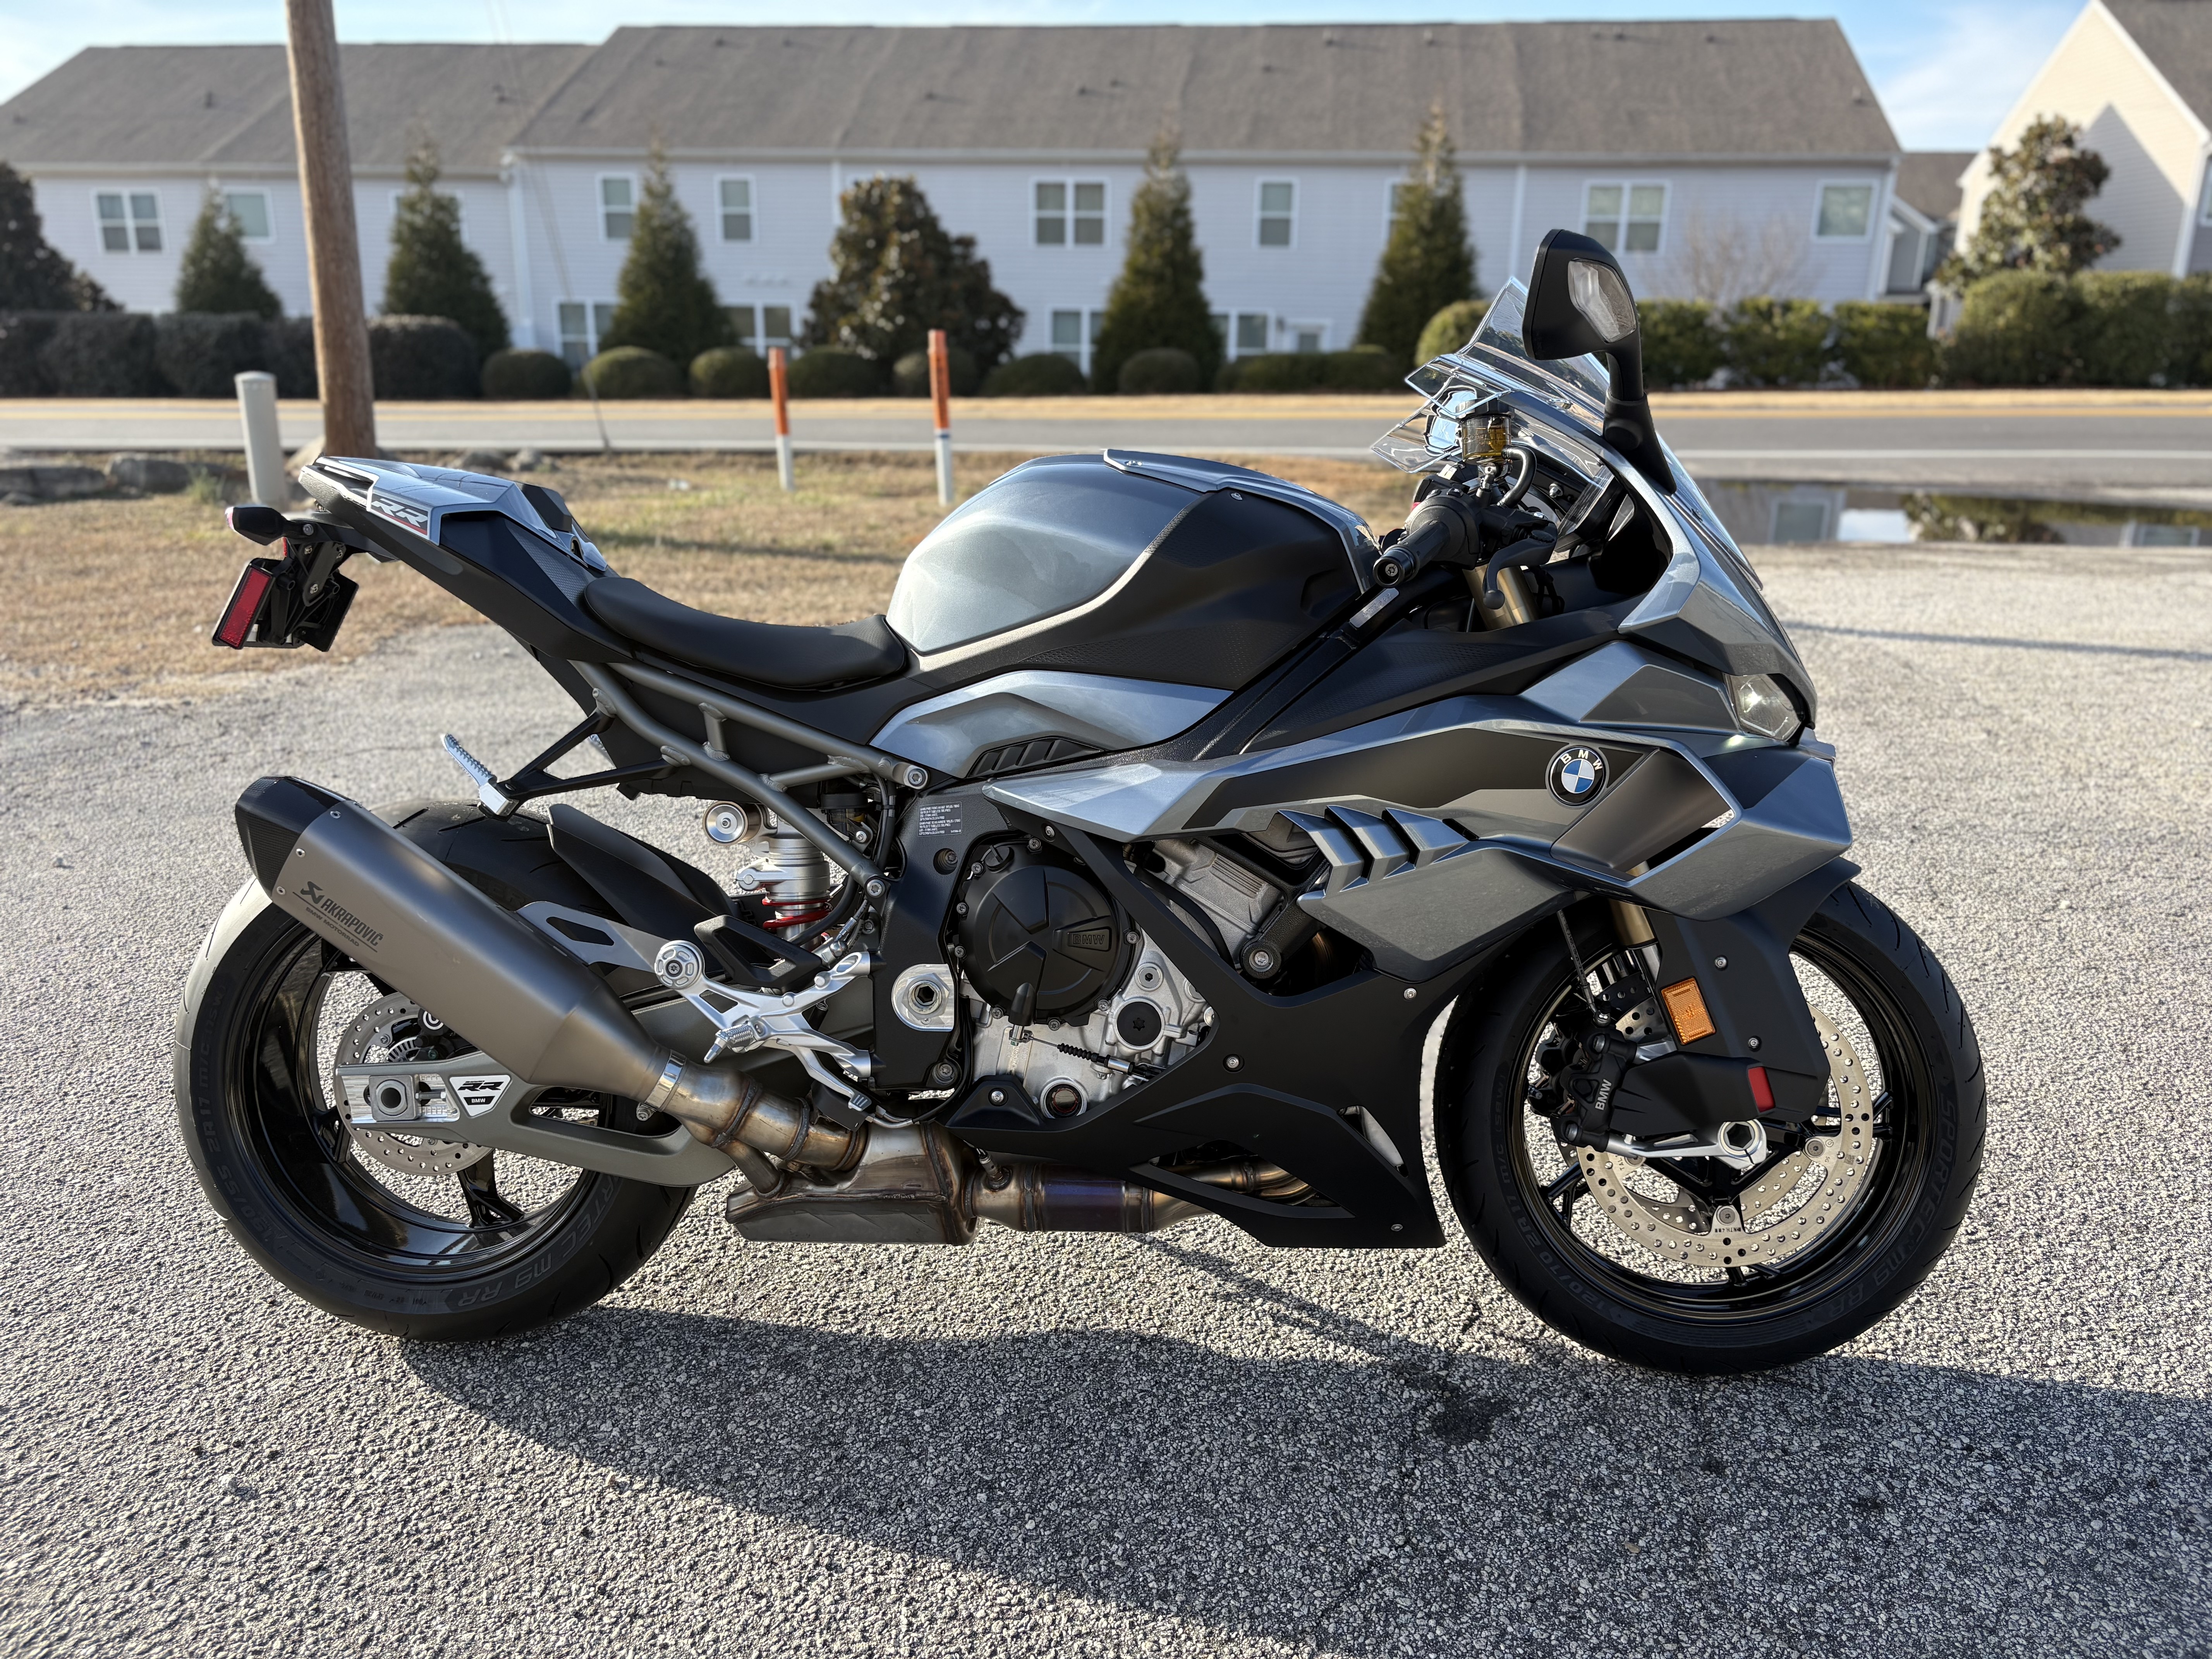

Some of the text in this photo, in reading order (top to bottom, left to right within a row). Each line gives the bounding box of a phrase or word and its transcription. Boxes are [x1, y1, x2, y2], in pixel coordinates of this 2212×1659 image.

[371, 498, 428, 527] RR
[1560, 749, 1602, 771] BMW
[306, 907, 322, 920] BMW
[323, 919, 359, 946] MOTORRAD
[1073, 934, 1105, 945] BMW
[457, 1082, 504, 1091] RR
[1595, 1079, 1612, 1110] BMW
[1909, 1093, 1956, 1243] SPORTEC
[457, 1281, 503, 1307] RR
[1539, 1251, 1606, 1309] 120/70
[1829, 1282, 1864, 1317] RR
